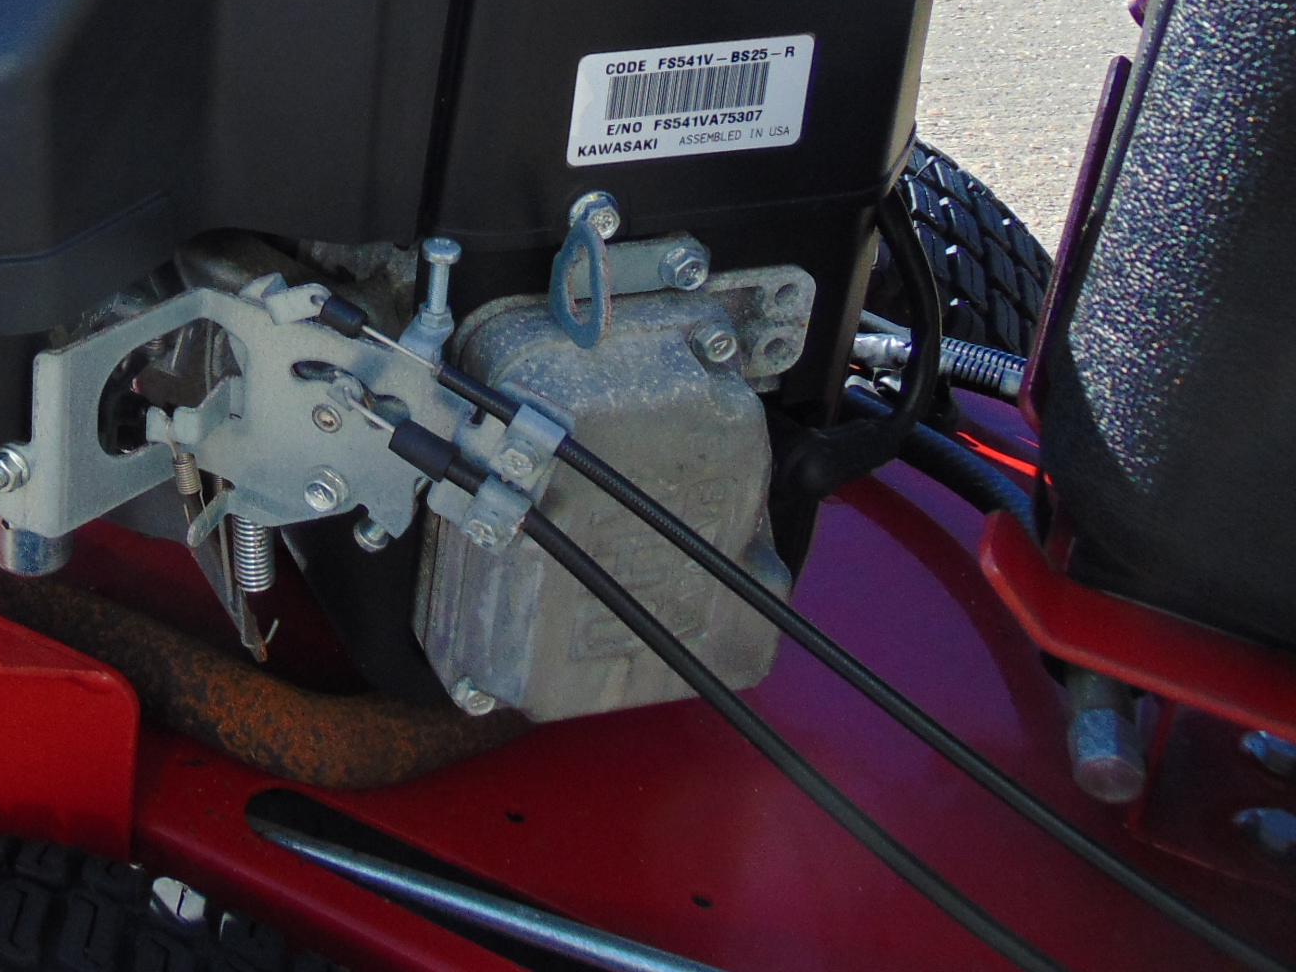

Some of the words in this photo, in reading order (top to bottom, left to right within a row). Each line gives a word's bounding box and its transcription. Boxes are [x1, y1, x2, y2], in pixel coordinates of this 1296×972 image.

[605, 60, 647, 76] CODE
[606, 121, 643, 136] E/NO
[653, 109, 763, 132] FS541VA75307
[678, 129, 742, 146] ASSEMBLED
[749, 127, 764, 139] IN
[769, 125, 791, 137] USA
[577, 138, 659, 158] KAWASAKI
